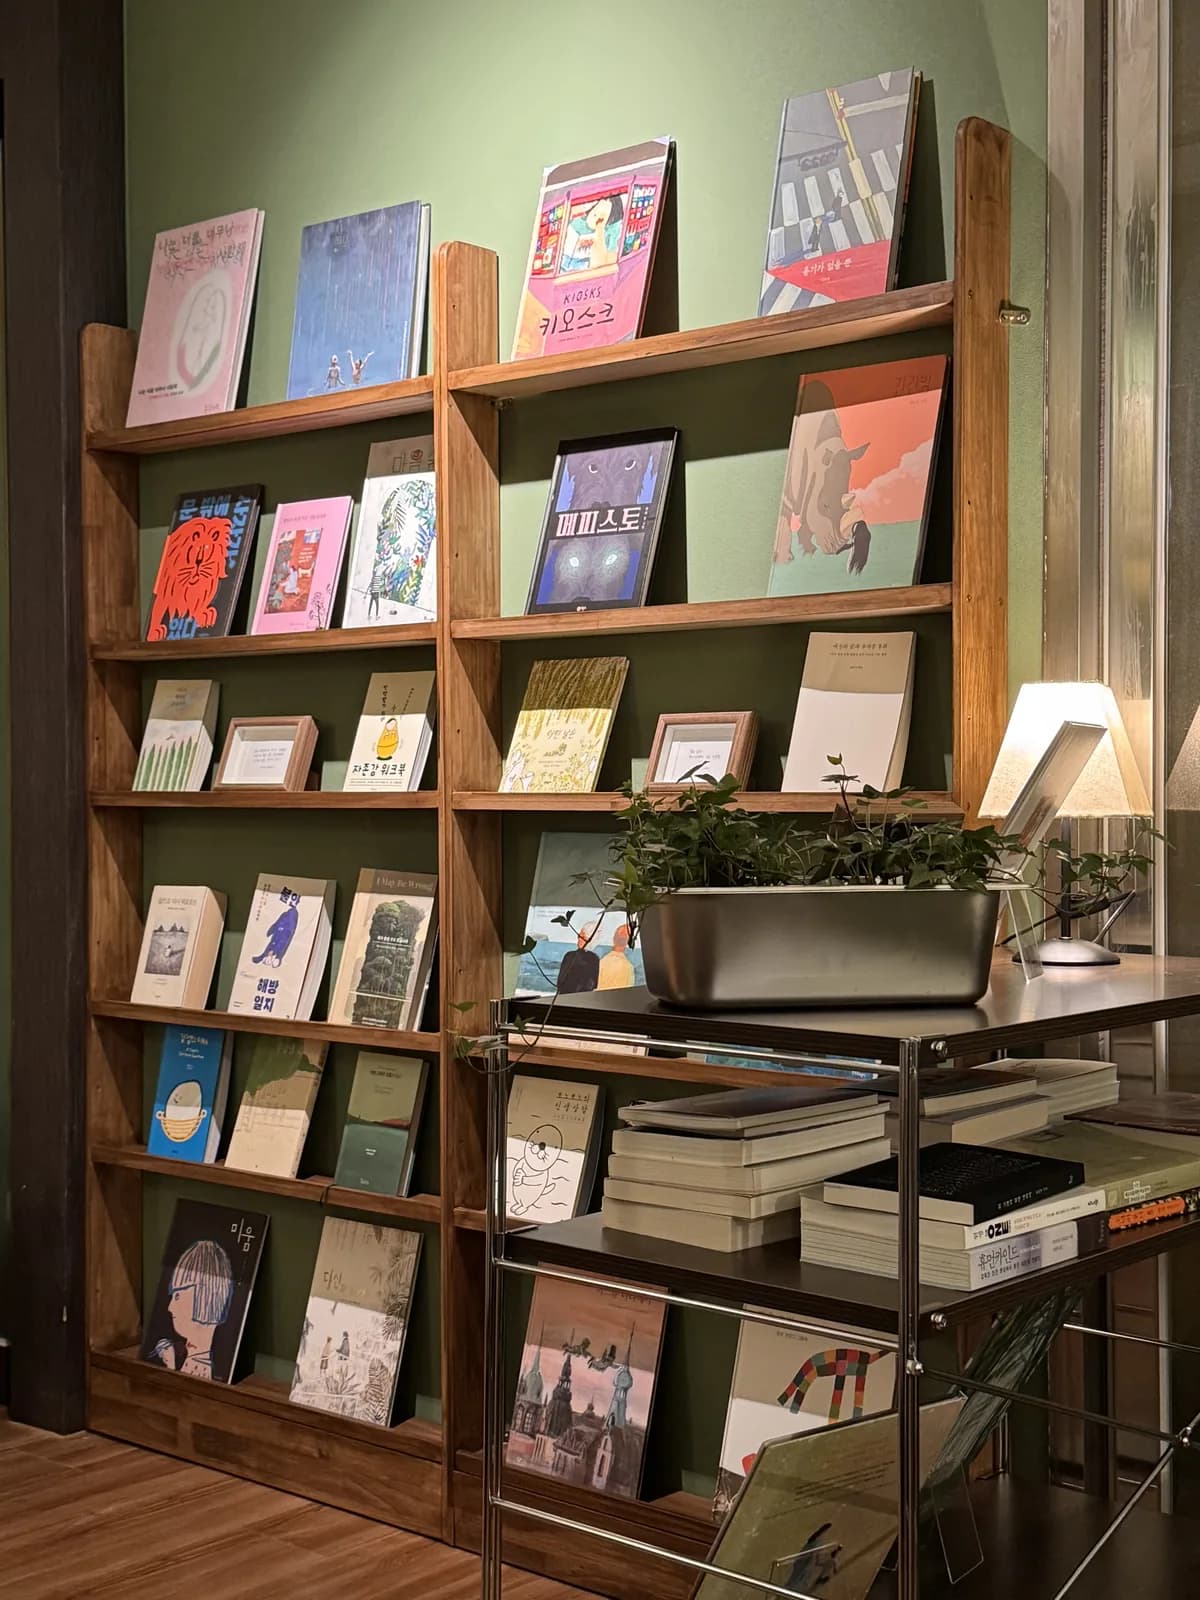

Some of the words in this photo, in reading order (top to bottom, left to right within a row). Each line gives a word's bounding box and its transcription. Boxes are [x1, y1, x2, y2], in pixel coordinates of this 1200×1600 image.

[563, 287, 602, 304] KIOSKS
[539, 303, 614, 336] 키오스크
[556, 507, 641, 537] 메피스토
[352, 763, 378, 777] 자존감
[380, 763, 406, 777] 워크북
[280, 886, 301, 909] 불안
[257, 978, 279, 995] 해방
[253, 995, 275, 1012] 일지
